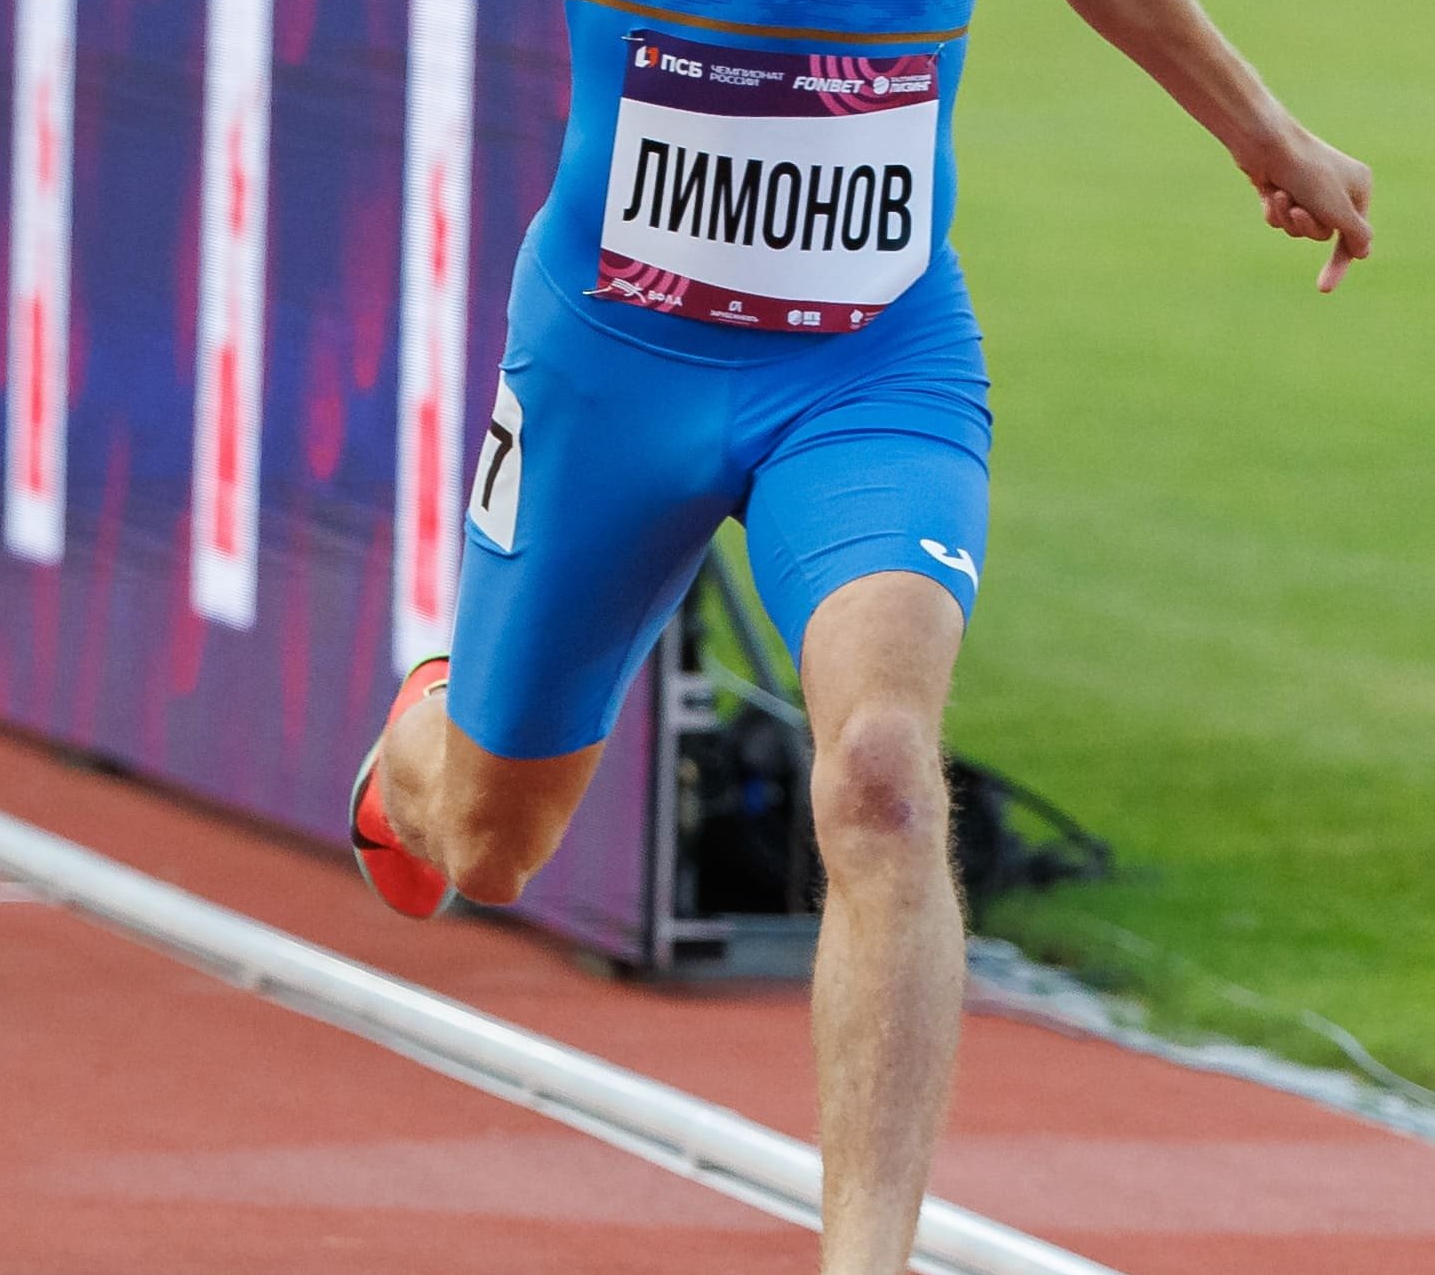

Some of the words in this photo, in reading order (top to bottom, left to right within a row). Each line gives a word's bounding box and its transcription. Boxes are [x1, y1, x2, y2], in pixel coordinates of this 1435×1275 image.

[660, 54, 703, 78] ПСБ
[710, 64, 786, 81] ЧЕМПИОНАТ
[793, 76, 865, 93] FONBET
[622, 137, 913, 252] ЛИМОНОВ
[481, 418, 514, 512] 7
